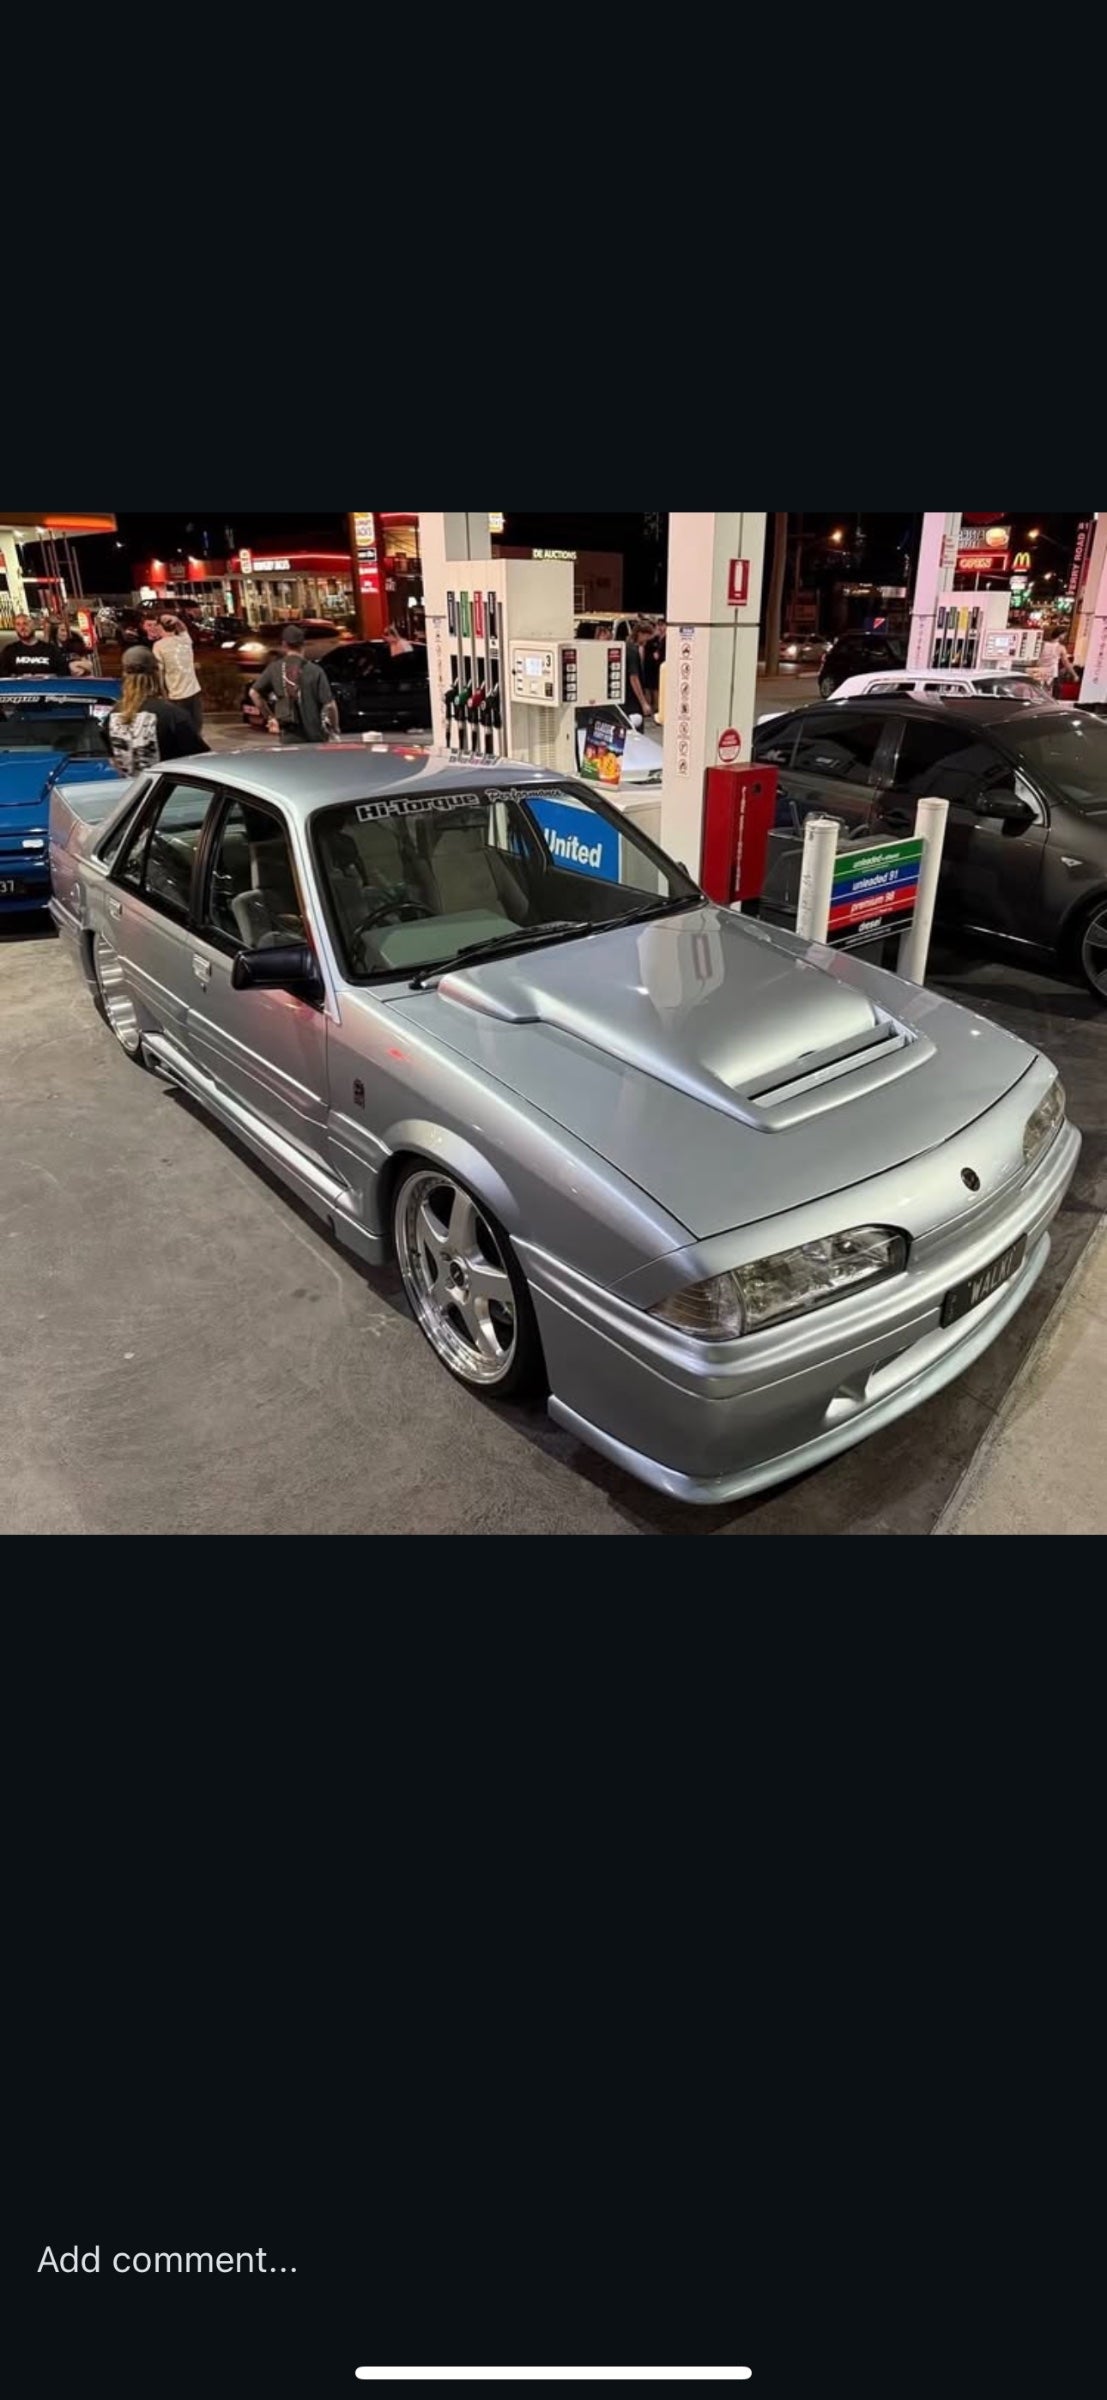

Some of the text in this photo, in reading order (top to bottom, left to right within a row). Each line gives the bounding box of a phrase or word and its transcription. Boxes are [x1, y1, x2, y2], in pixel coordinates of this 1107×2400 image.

[545, 655, 551, 667] 3
[356, 794, 480, 822] Hi-Torque
[544, 828, 603, 868] United
[852, 872, 889, 891] unleaded
[858, 916, 882, 933] diesel
